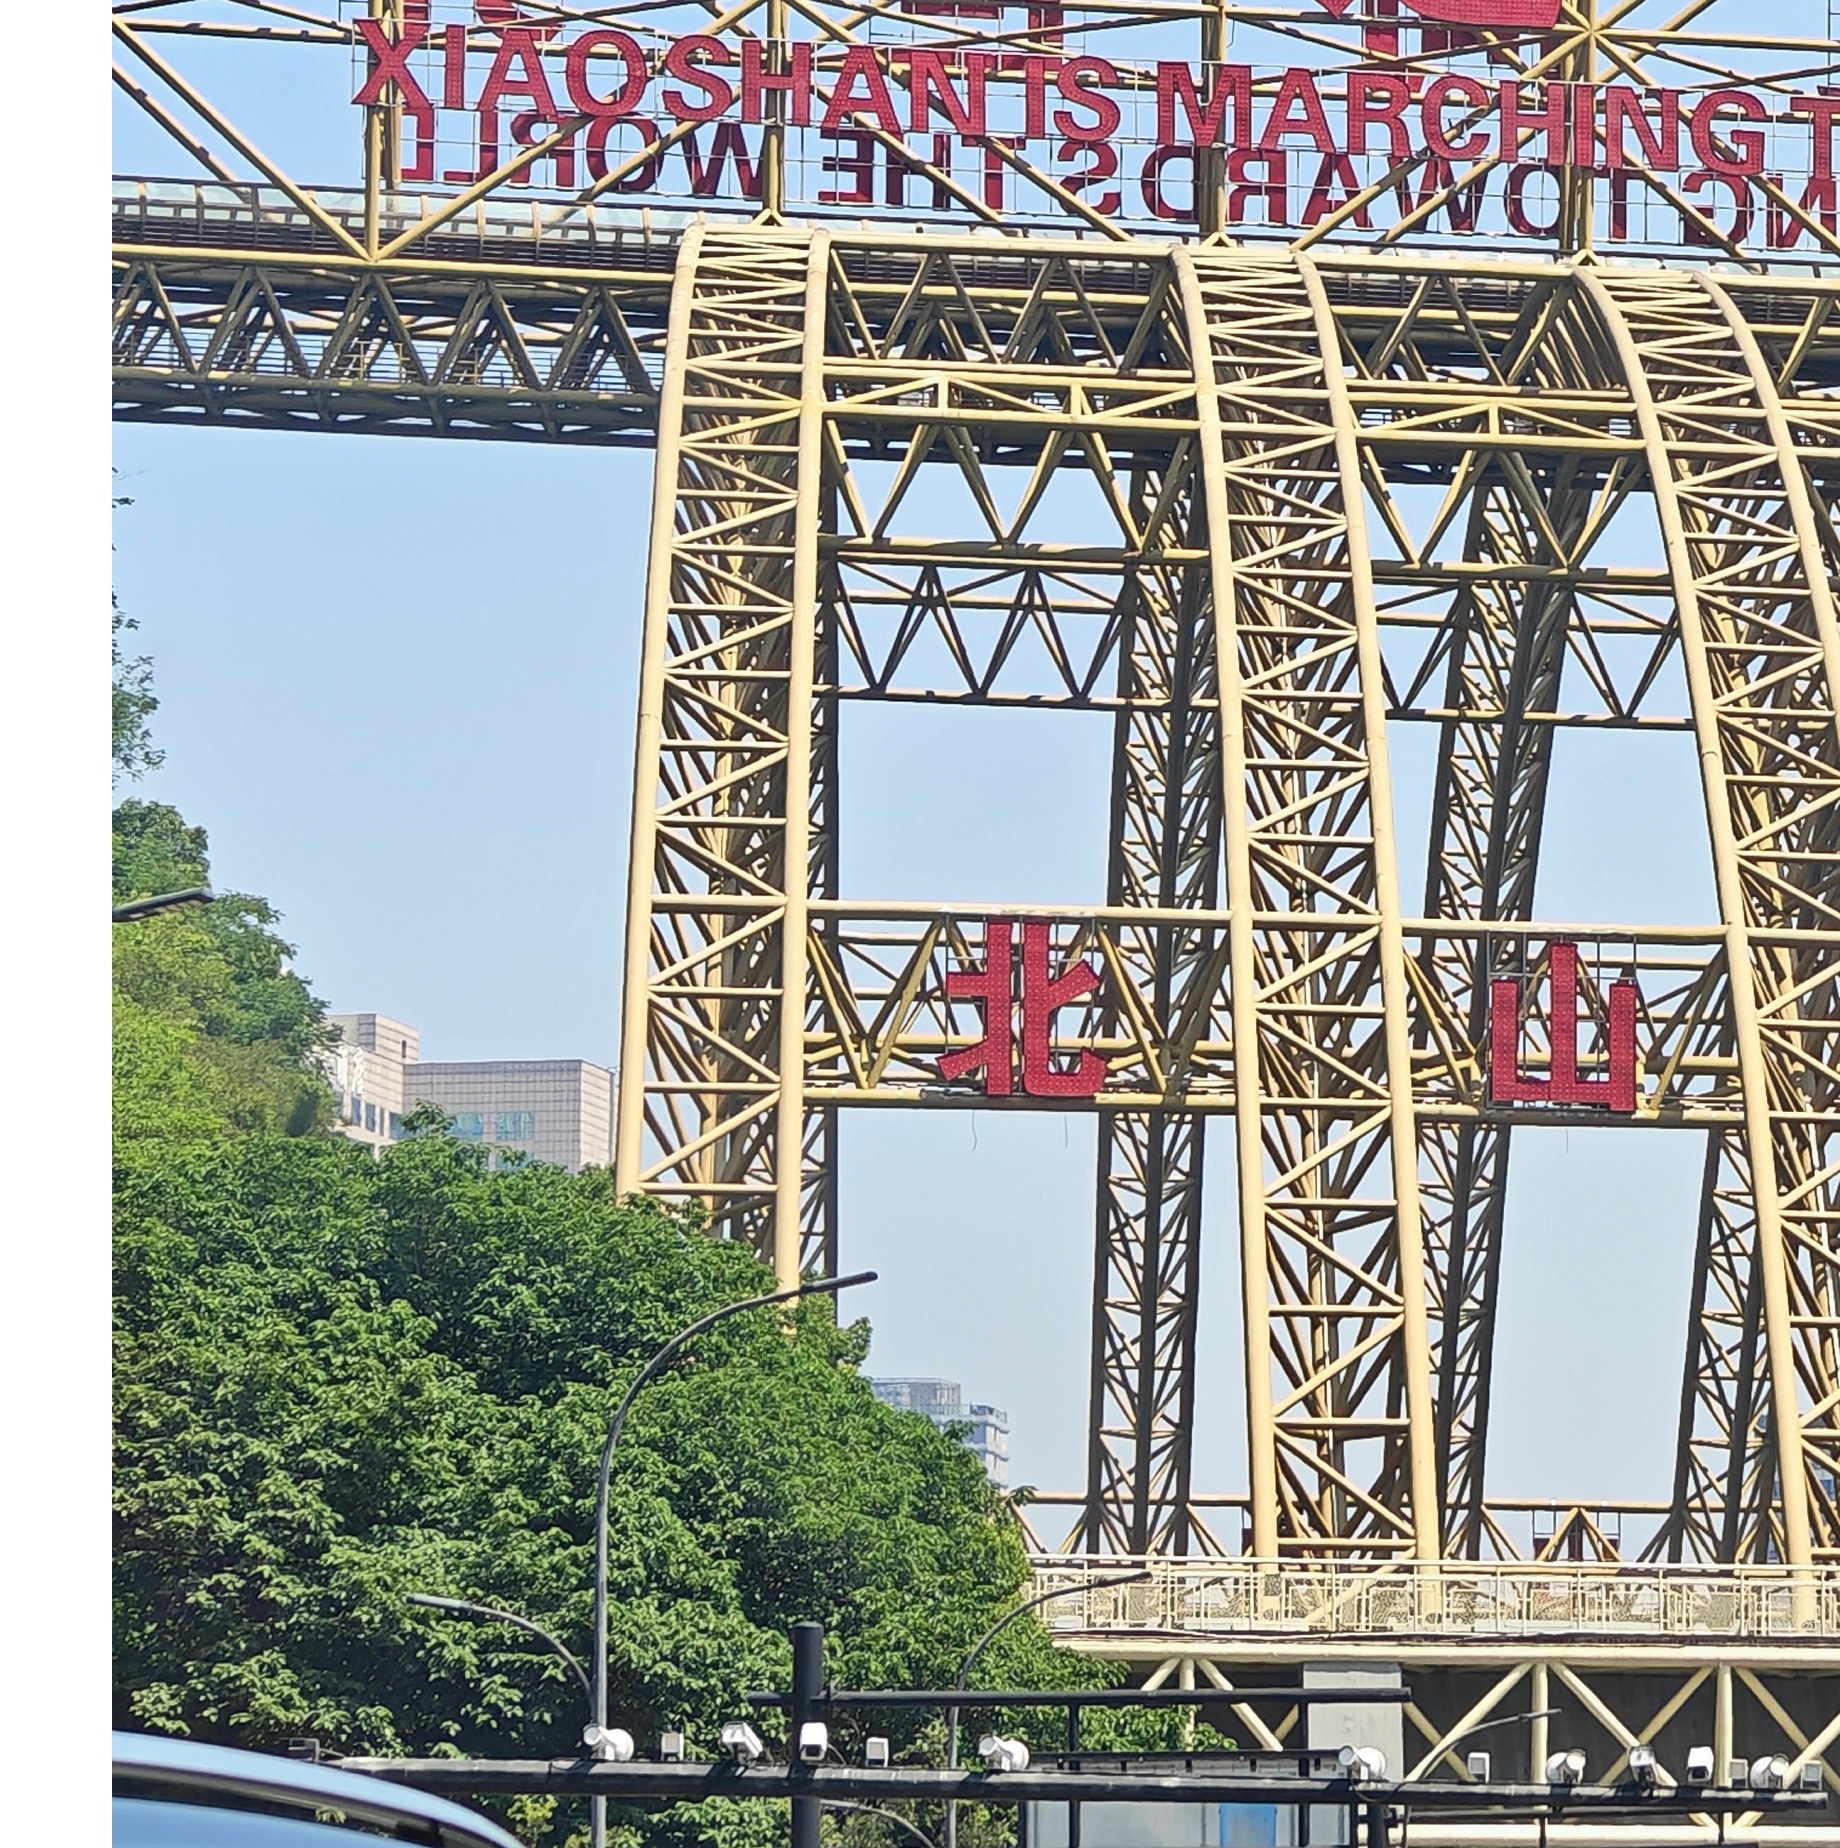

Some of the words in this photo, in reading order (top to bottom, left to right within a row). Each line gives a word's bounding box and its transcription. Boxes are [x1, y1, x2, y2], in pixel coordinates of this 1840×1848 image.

[352, 18, 987, 136] XIAOSHAN
[1024, 55, 1120, 142] IS
[1156, 61, 1768, 174] MARCHING
